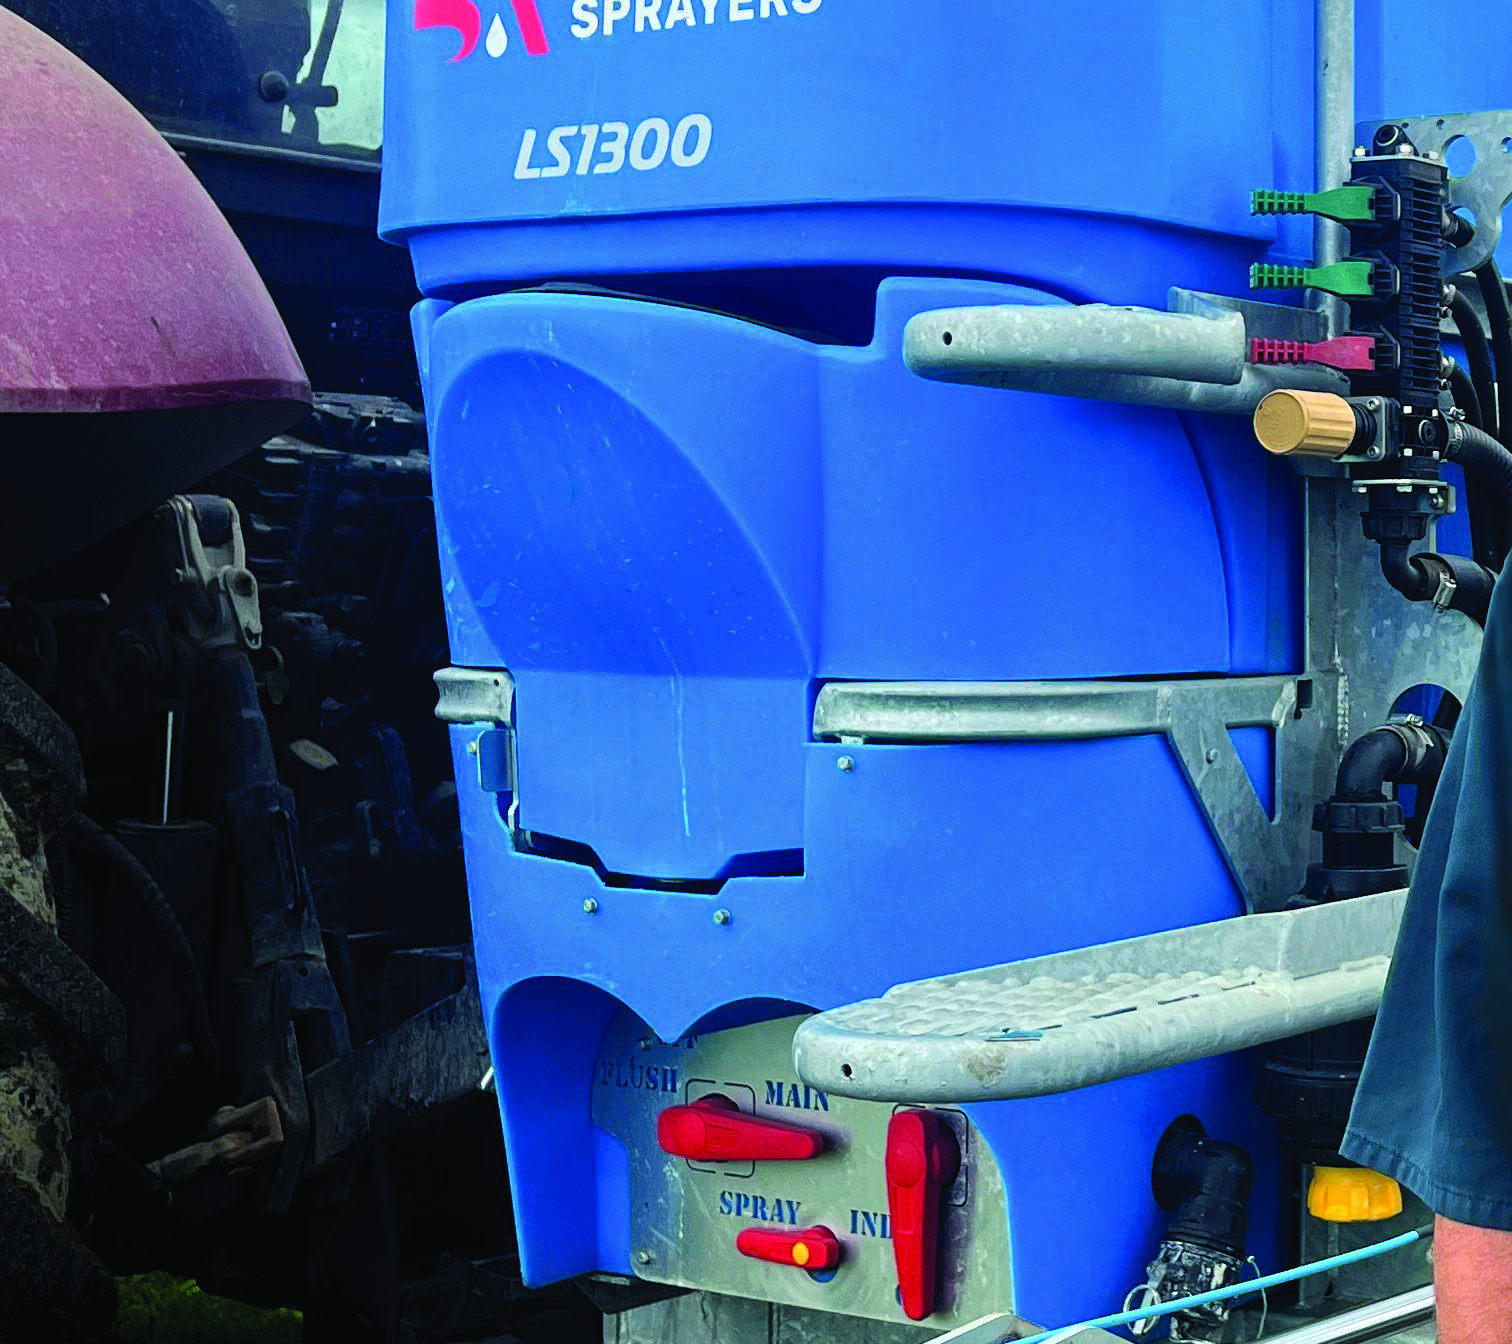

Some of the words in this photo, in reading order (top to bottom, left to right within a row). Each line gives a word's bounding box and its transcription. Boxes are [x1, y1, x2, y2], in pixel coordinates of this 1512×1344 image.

[513, 112, 713, 180] LS1300
[601, 1060, 678, 1094] FLUSH
[765, 1079, 830, 1112] MAIN
[719, 1189, 801, 1225] SPRAY
